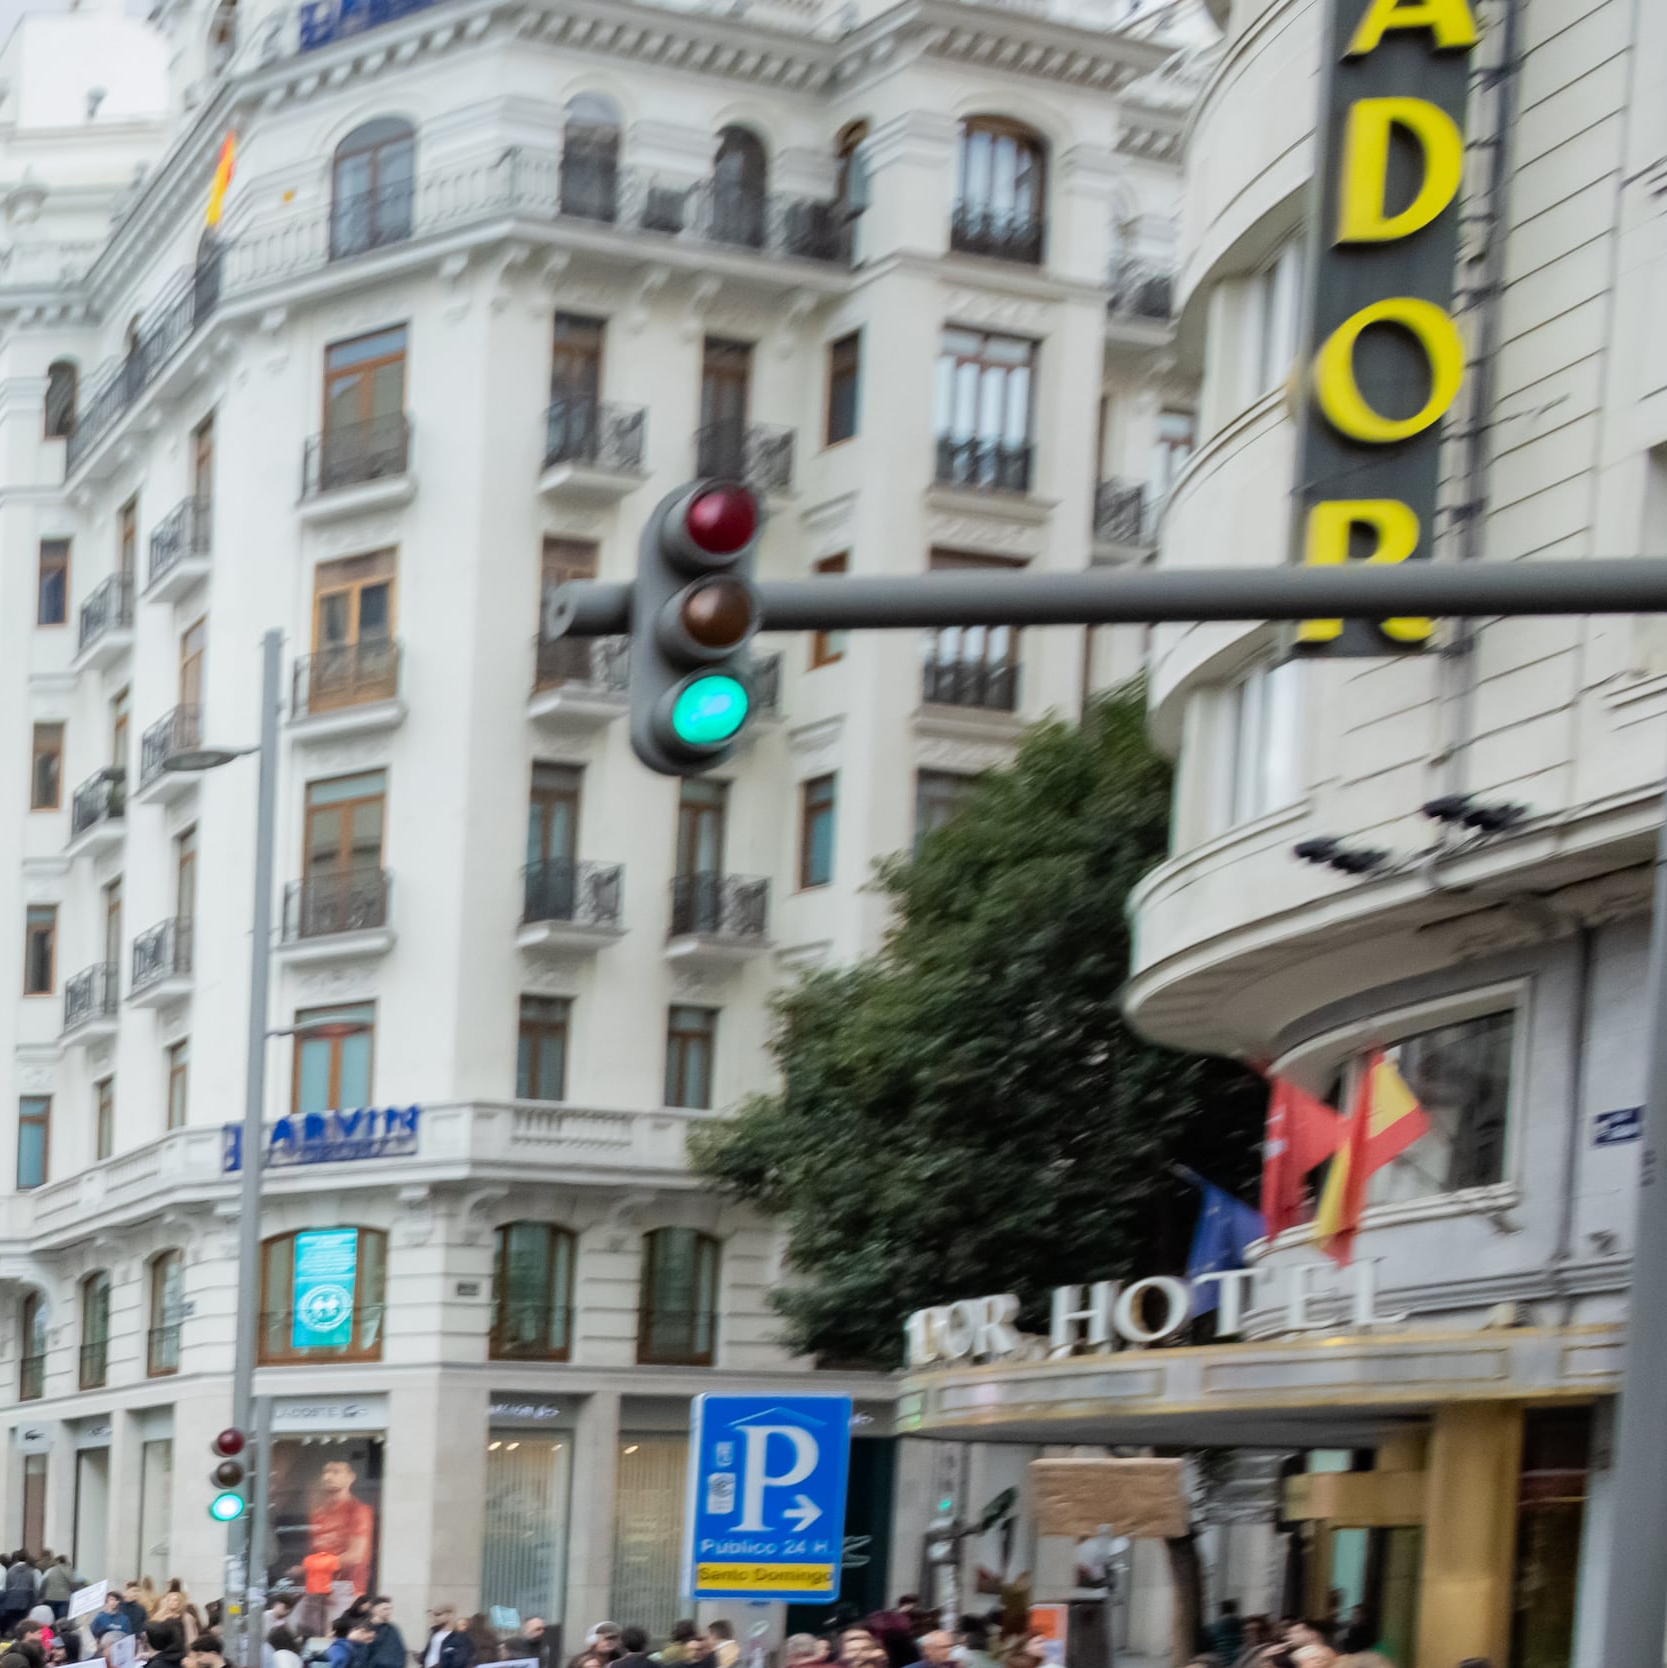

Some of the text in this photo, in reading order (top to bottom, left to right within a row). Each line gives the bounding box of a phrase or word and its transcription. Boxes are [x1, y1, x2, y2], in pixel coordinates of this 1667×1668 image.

[1051, 1258, 1409, 1350] HOTEL
[729, 1425, 820, 1532] P
[701, 1539, 777, 1554] Público
[781, 1539, 806, 1554] 24
[699, 1567, 832, 1585] Santo Domingo
